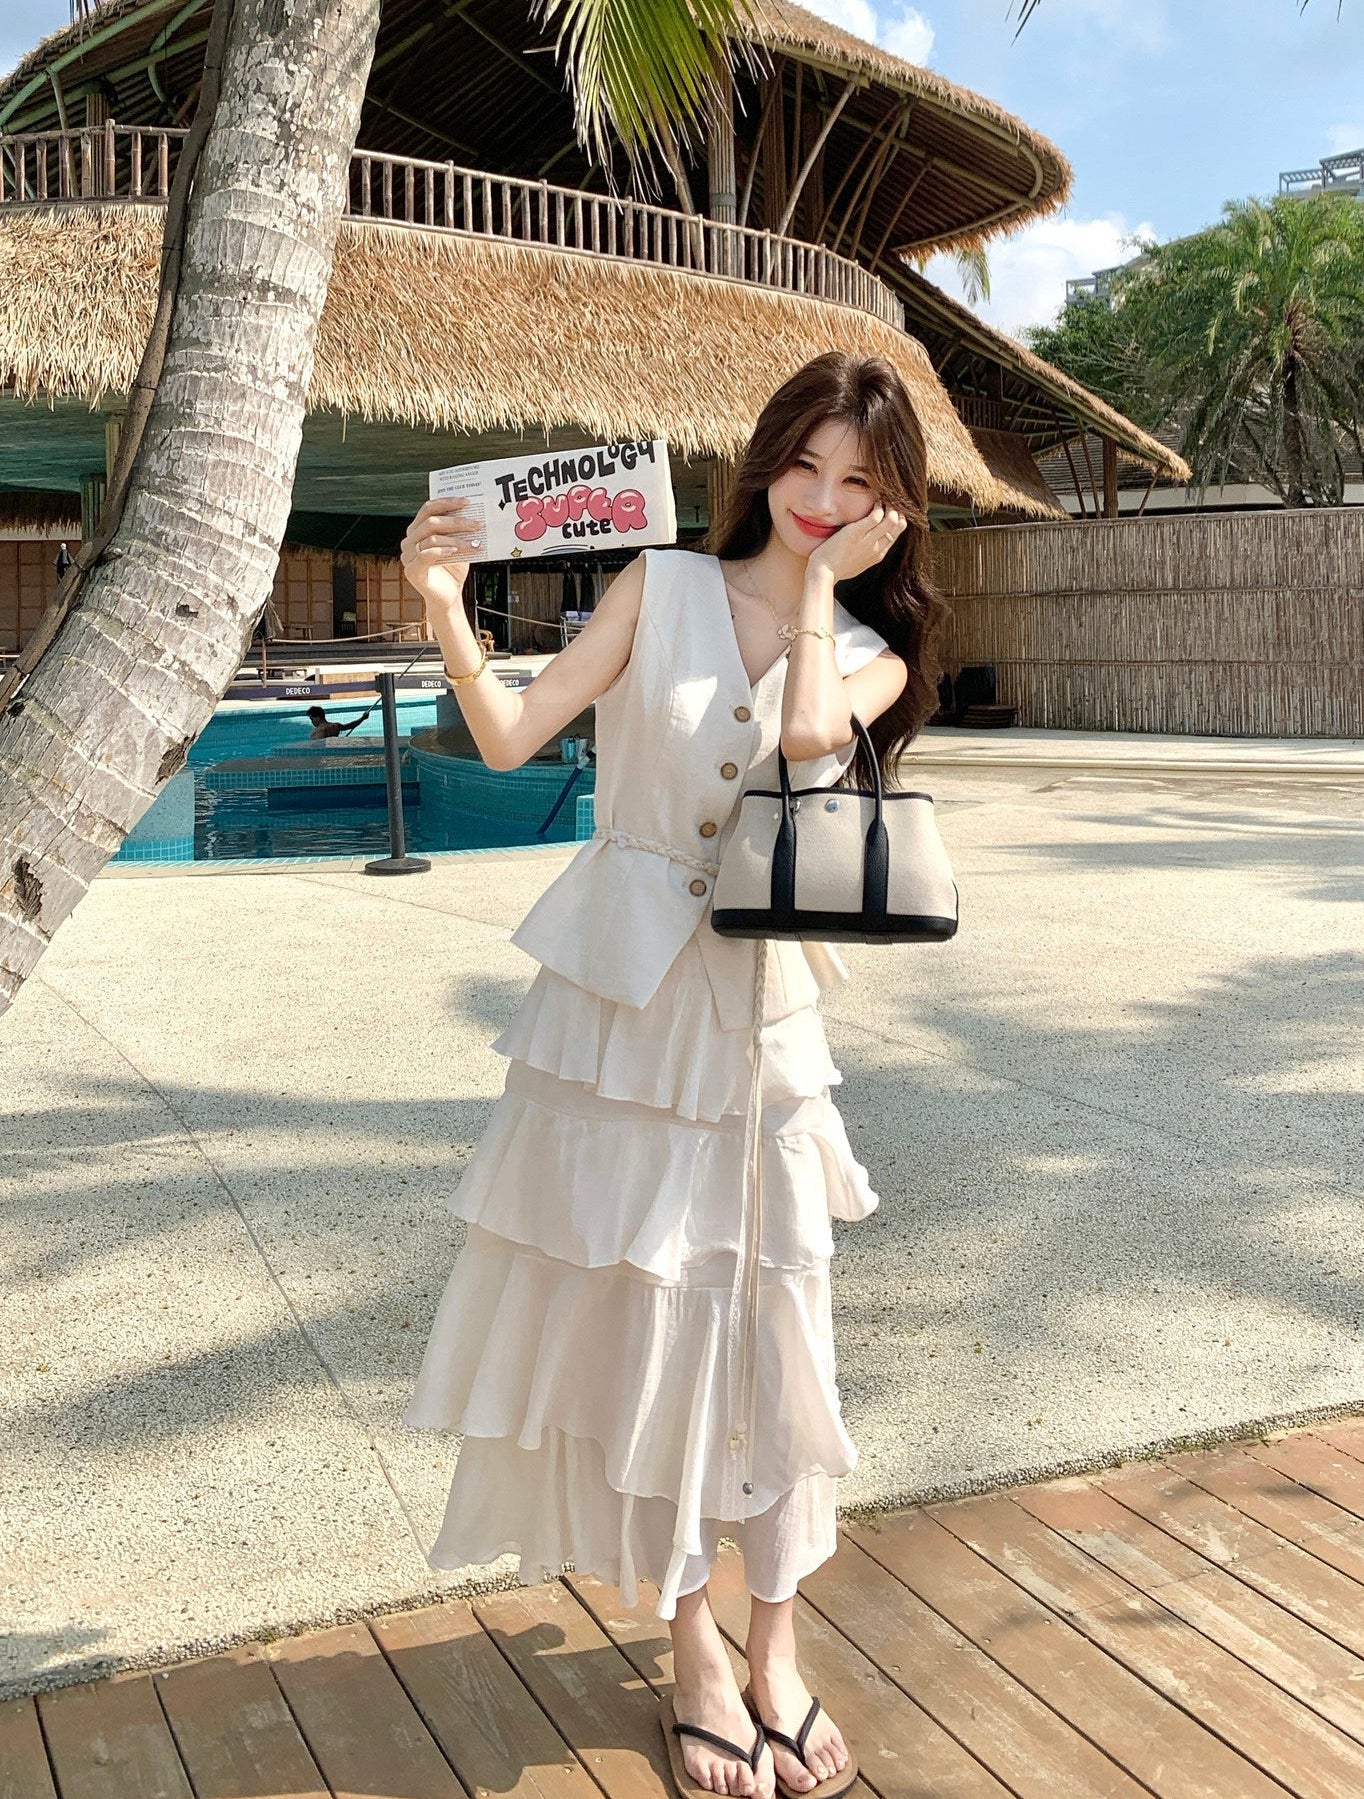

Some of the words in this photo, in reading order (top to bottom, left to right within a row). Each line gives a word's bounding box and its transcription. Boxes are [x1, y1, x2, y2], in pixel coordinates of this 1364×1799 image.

[494, 441, 655, 503] TECHNOLOGY
[514, 484, 648, 542] SUPER
[562, 518, 612, 539] cute
[286, 687, 310, 695] DEDECO
